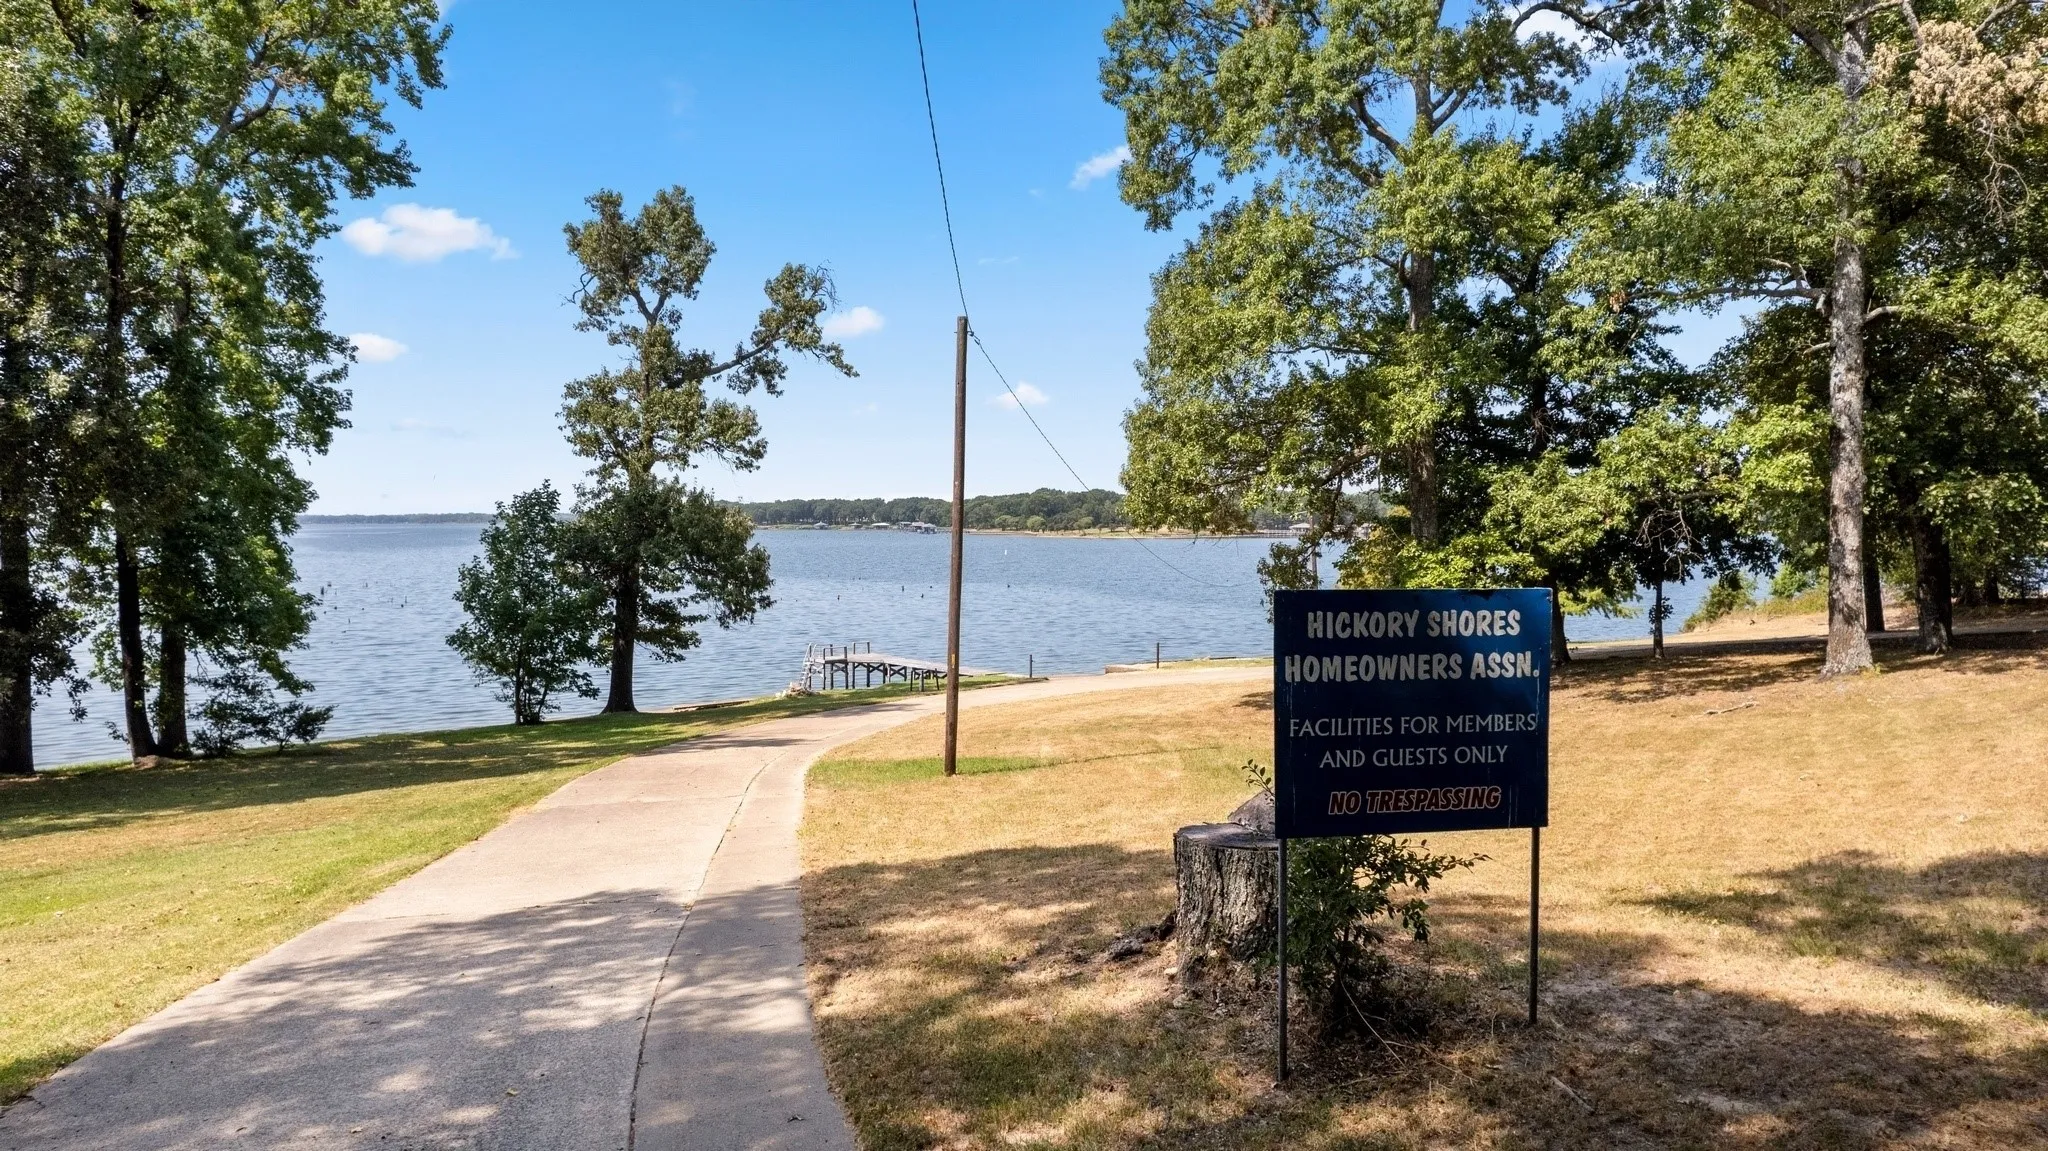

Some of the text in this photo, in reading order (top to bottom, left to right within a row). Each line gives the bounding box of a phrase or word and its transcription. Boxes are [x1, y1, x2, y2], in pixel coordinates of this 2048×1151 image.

[1307, 609, 1521, 639] HICKORY SHORES
[1284, 651, 1540, 682] HOMEOWNERS ASSN.
[1289, 713, 1537, 737] FACILITIES FOR MEMBERS
[1319, 745, 1508, 768] AND GUESTS ONLY
[1328, 786, 1502, 815] NO TRESPASSING
